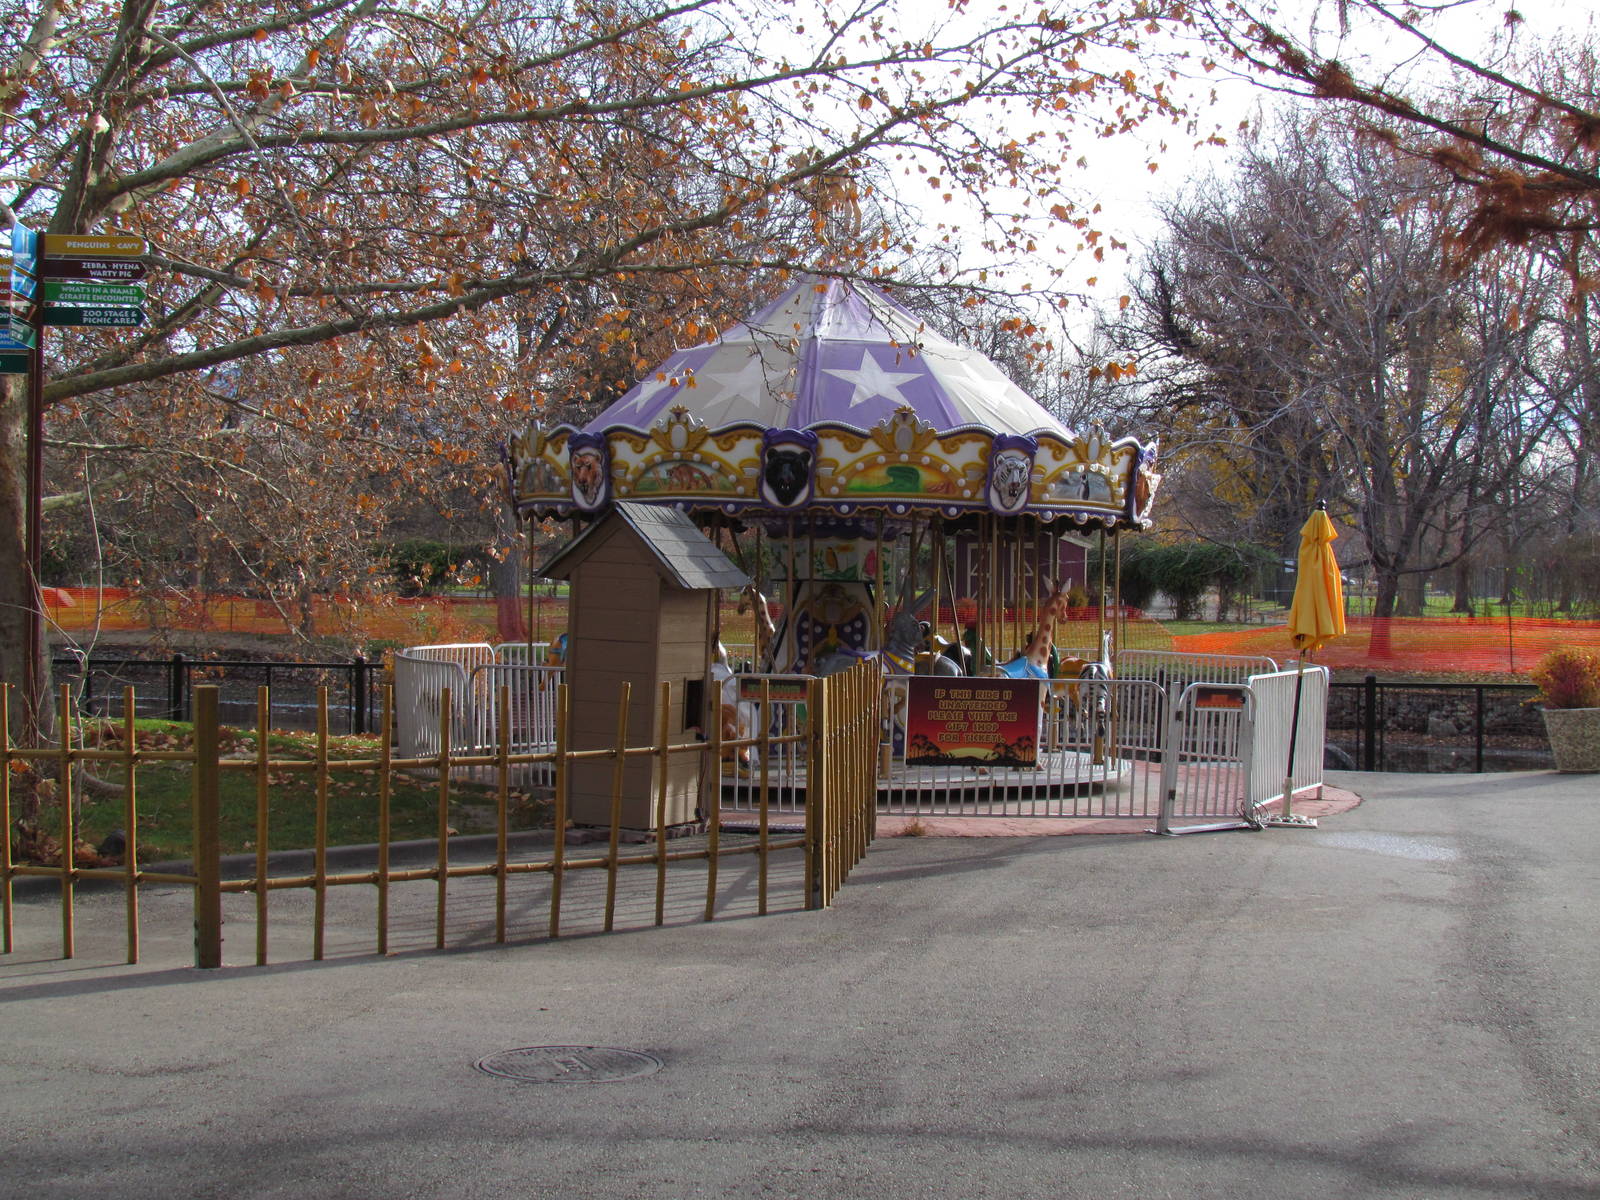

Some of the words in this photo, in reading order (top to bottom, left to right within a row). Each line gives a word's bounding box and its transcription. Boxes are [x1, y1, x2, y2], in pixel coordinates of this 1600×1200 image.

[66, 241, 111, 249] PENGUINS
[59, 293, 91, 301] GIRAFFE
[92, 294, 139, 303] ENCOUNTER
[935, 690, 946, 699] IF
[950, 690, 972, 699] THIS
[976, 691, 1000, 700] RIDE
[940, 700, 1007, 711] UNATTENDED
[928, 711, 964, 721] PLEASE
[969, 712, 993, 722] VISIT
[997, 712, 1017, 722] THE
[946, 722, 968, 731] GIFT
[973, 723, 999, 732] SHOP
[938, 733, 960, 742] FOR
